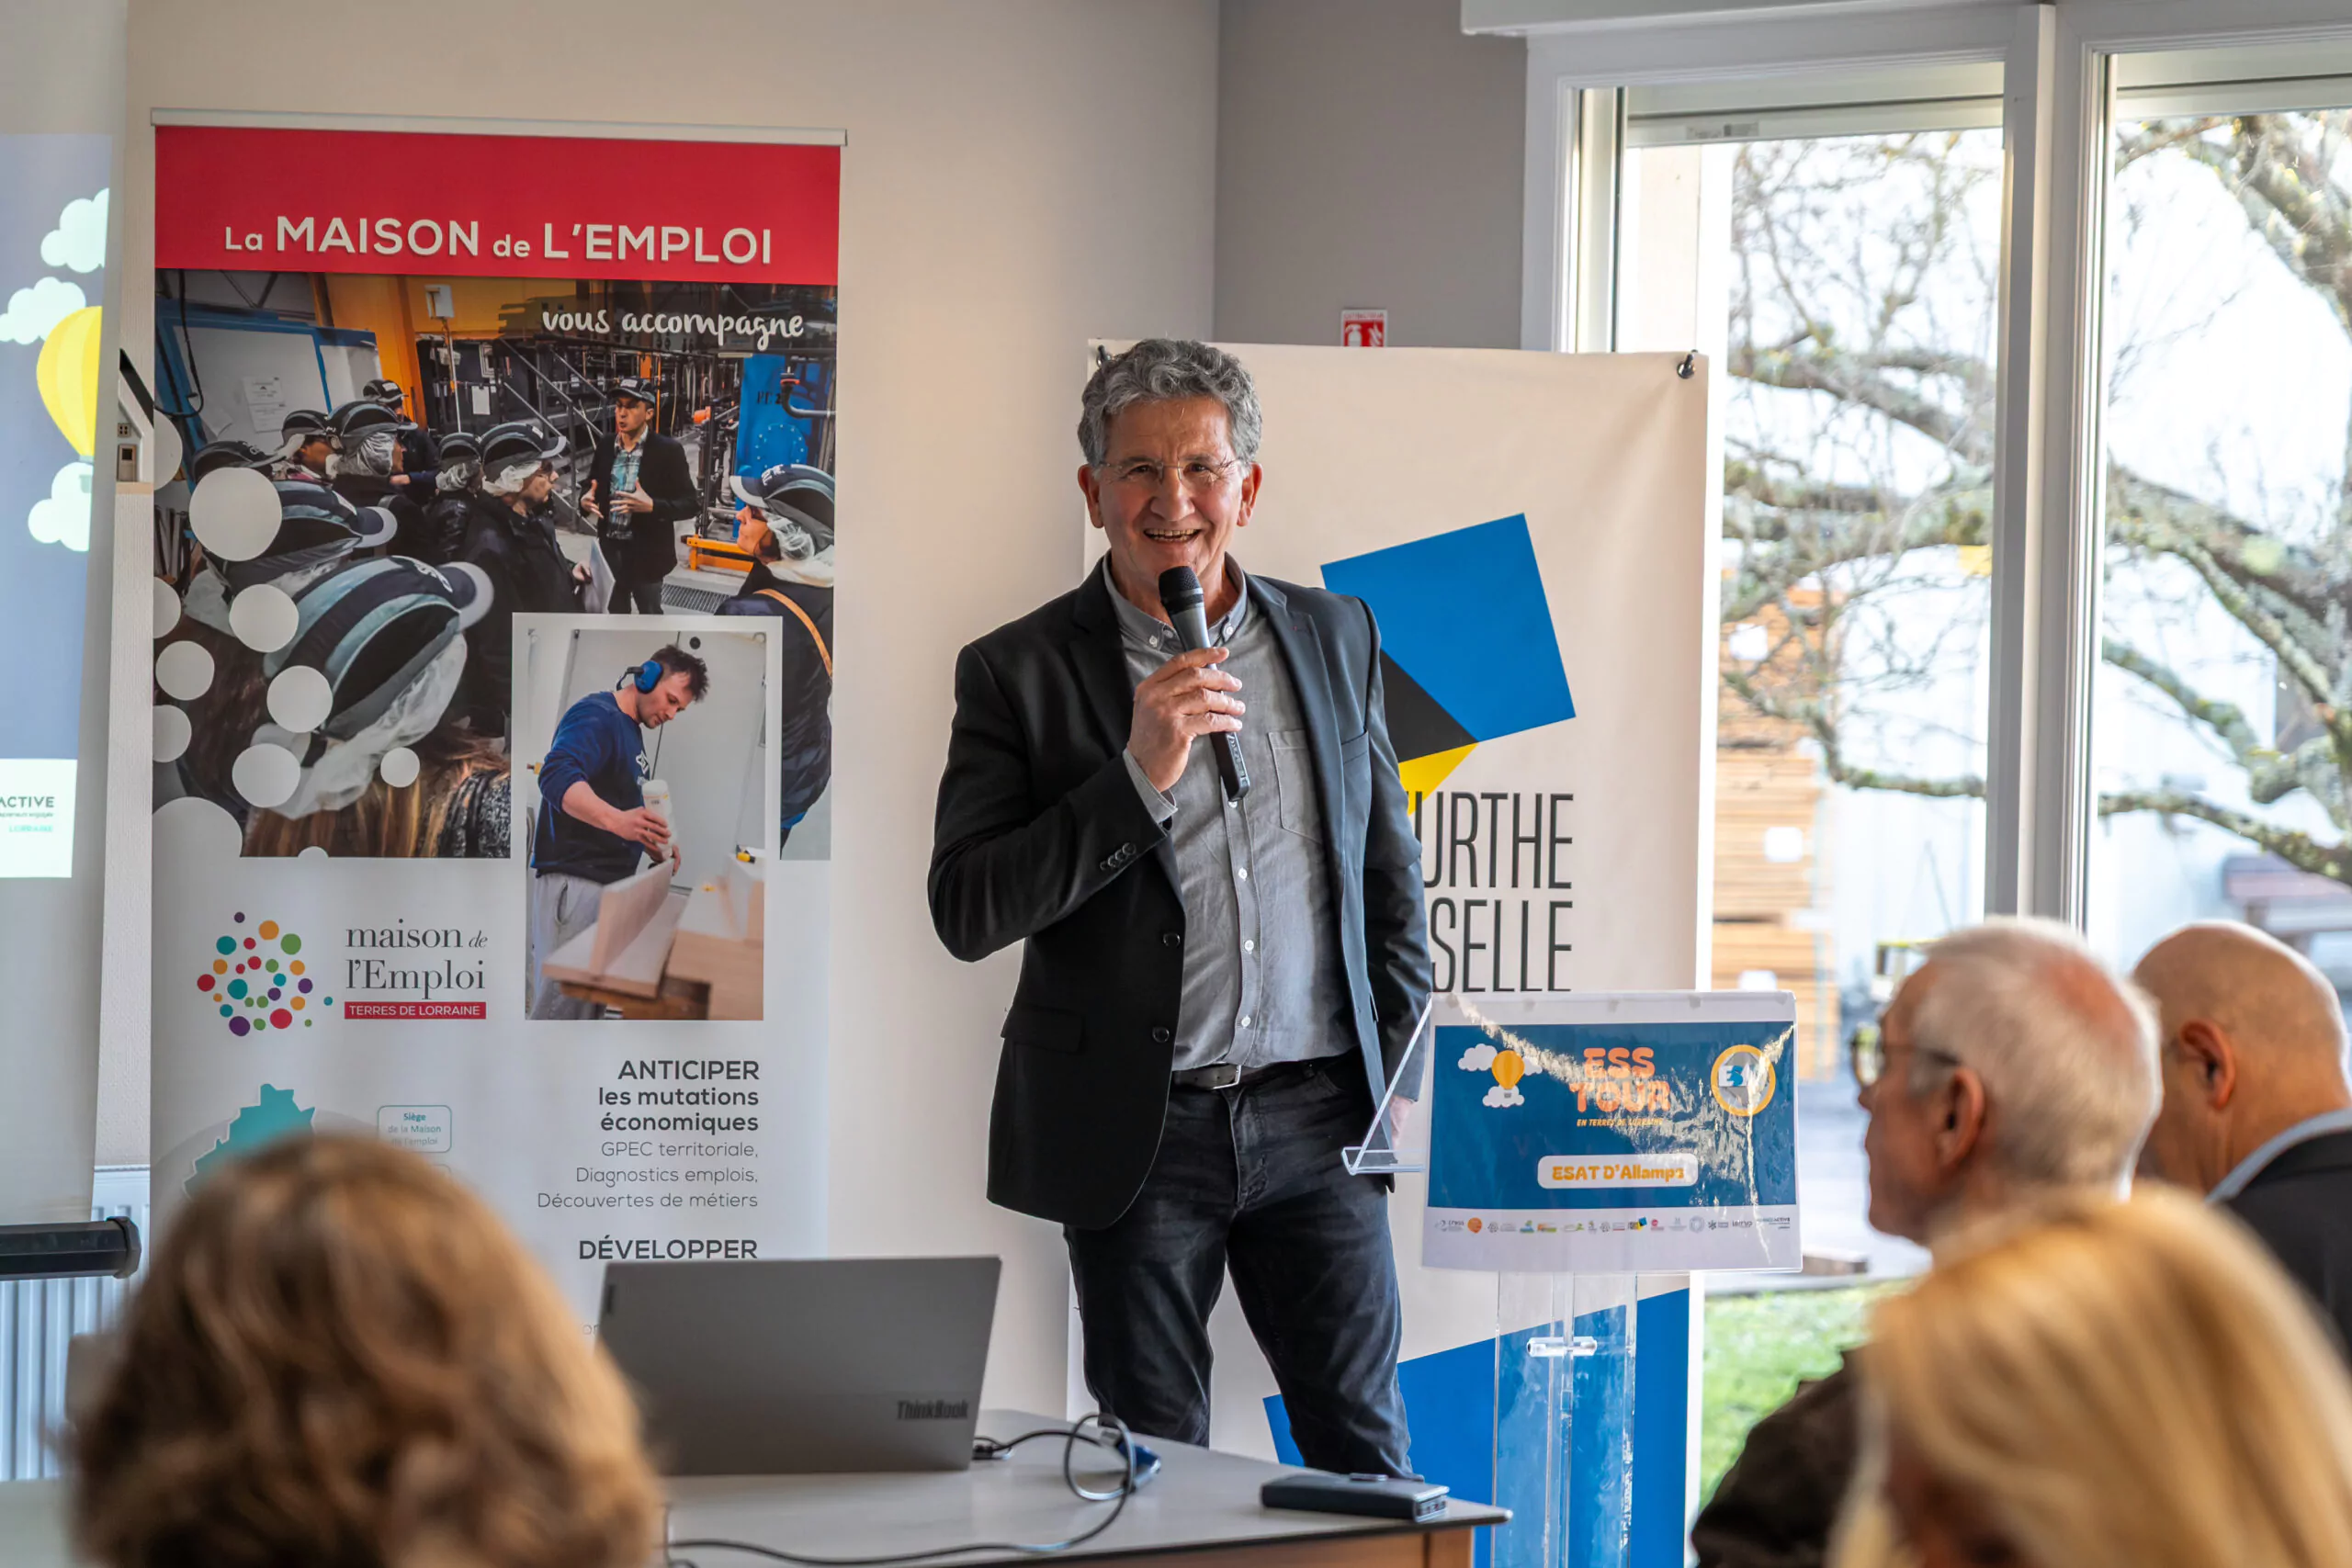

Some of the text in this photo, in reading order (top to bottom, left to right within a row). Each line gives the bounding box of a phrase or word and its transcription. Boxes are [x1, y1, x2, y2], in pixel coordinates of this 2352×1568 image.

[225, 215, 771, 265] La MAISON de L'EMPLOI
[542, 308, 805, 351] vous accompagne
[1404, 790, 1574, 888] URTHE
[345, 919, 489, 949] maison de
[1430, 897, 1573, 993] SELLE
[345, 959, 486, 1000] l'Emploi
[349, 1005, 481, 1016] TERRES DE LORRAINE
[617, 1060, 760, 1080] ANTICIPER
[1583, 1047, 1656, 1078] ESS
[599, 1087, 759, 1105] les mutations
[1568, 1080, 1671, 1112] TOUR
[411, 1125, 441, 1134] Maison
[600, 1112, 759, 1135] économiques
[1577, 1118, 1588, 1126] EN
[1589, 1118, 1615, 1126] TERRES
[601, 1142, 758, 1157] GPEC territoriale,
[576, 1168, 758, 1188] Diagnostics emplois,
[1552, 1164, 1684, 1182] ESAT D'Allamps
[537, 1193, 758, 1208] Découvertes de métiers
[579, 1235, 758, 1259] DÉVELOPPER
[897, 1399, 968, 1419] ThinkBook
